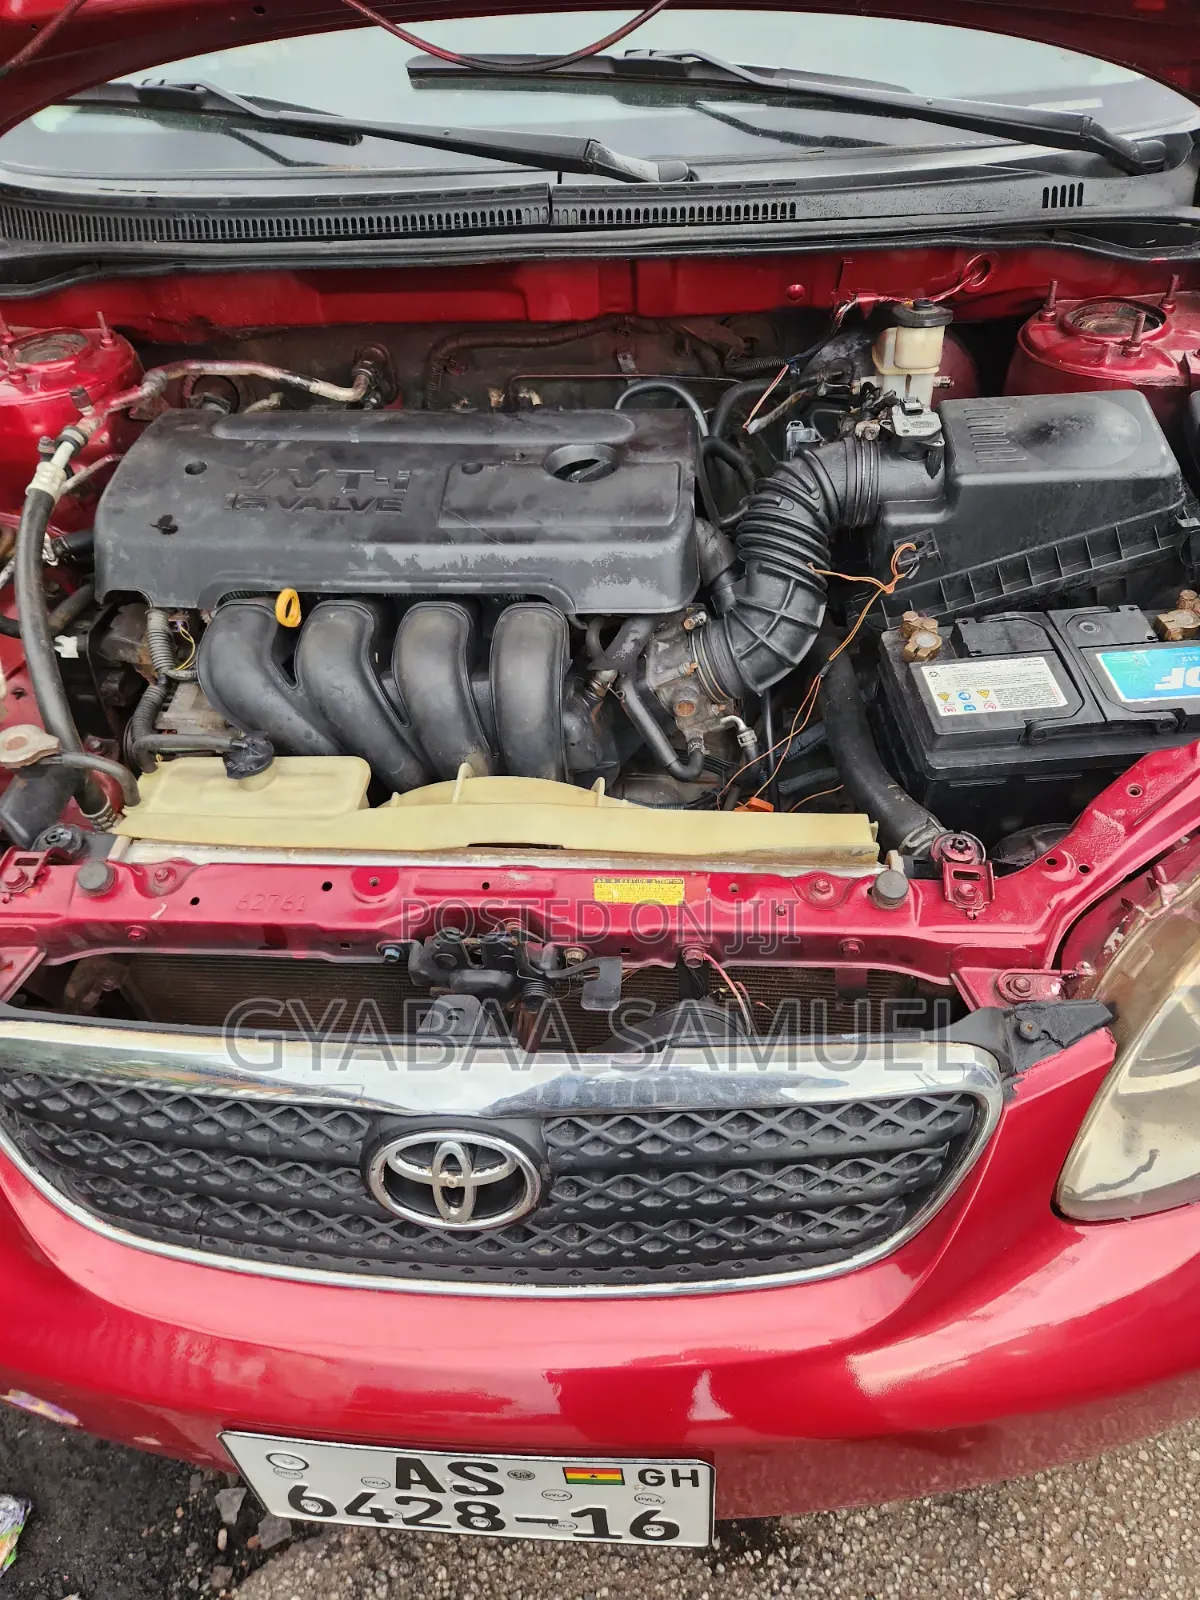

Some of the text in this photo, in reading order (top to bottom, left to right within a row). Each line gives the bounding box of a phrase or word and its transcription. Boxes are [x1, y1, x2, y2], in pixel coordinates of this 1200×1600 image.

[277, 495, 404, 514] VALVE
[235, 893, 307, 912] 62761
[395, 1456, 504, 1496] AS
[637, 1468, 700, 1488] GH
[287, 1484, 680, 1541] 6428-16
